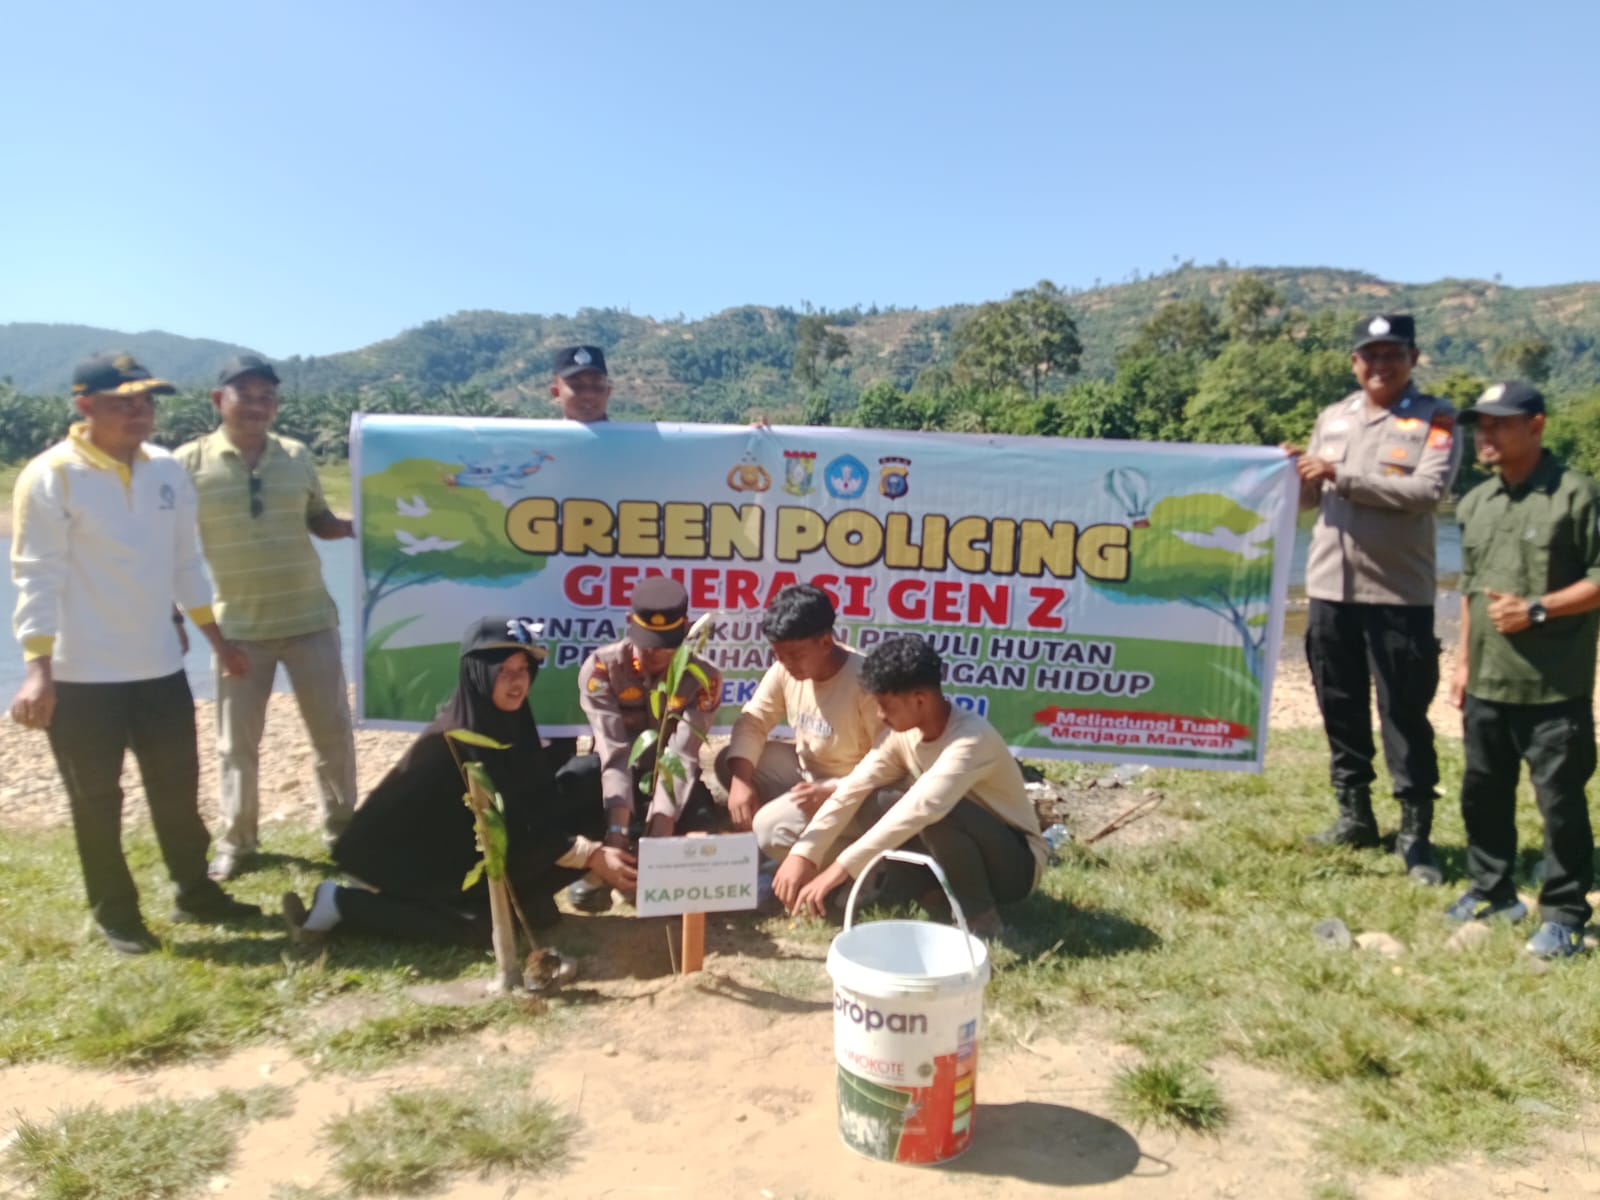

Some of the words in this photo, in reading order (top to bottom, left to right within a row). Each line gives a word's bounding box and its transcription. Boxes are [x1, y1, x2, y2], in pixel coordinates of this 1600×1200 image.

[505, 496, 764, 561] GREEN
[775, 505, 1130, 581] POLICING
[564, 565, 872, 616] GEERSI
[888, 579, 1009, 625] GEN
[1028, 587, 1065, 629] Z
[859, 630, 979, 656] PULI
[992, 638, 1112, 665] HUTAN
[1037, 668, 1151, 695] HIDUP
[1055, 711, 1176, 733] Melindungi
[1180, 719, 1230, 734] Tuah
[1051, 727, 1141, 746] Menjaga
[1146, 733, 1233, 748] Marwah
[644, 884, 752, 903] KAPOLSEK
